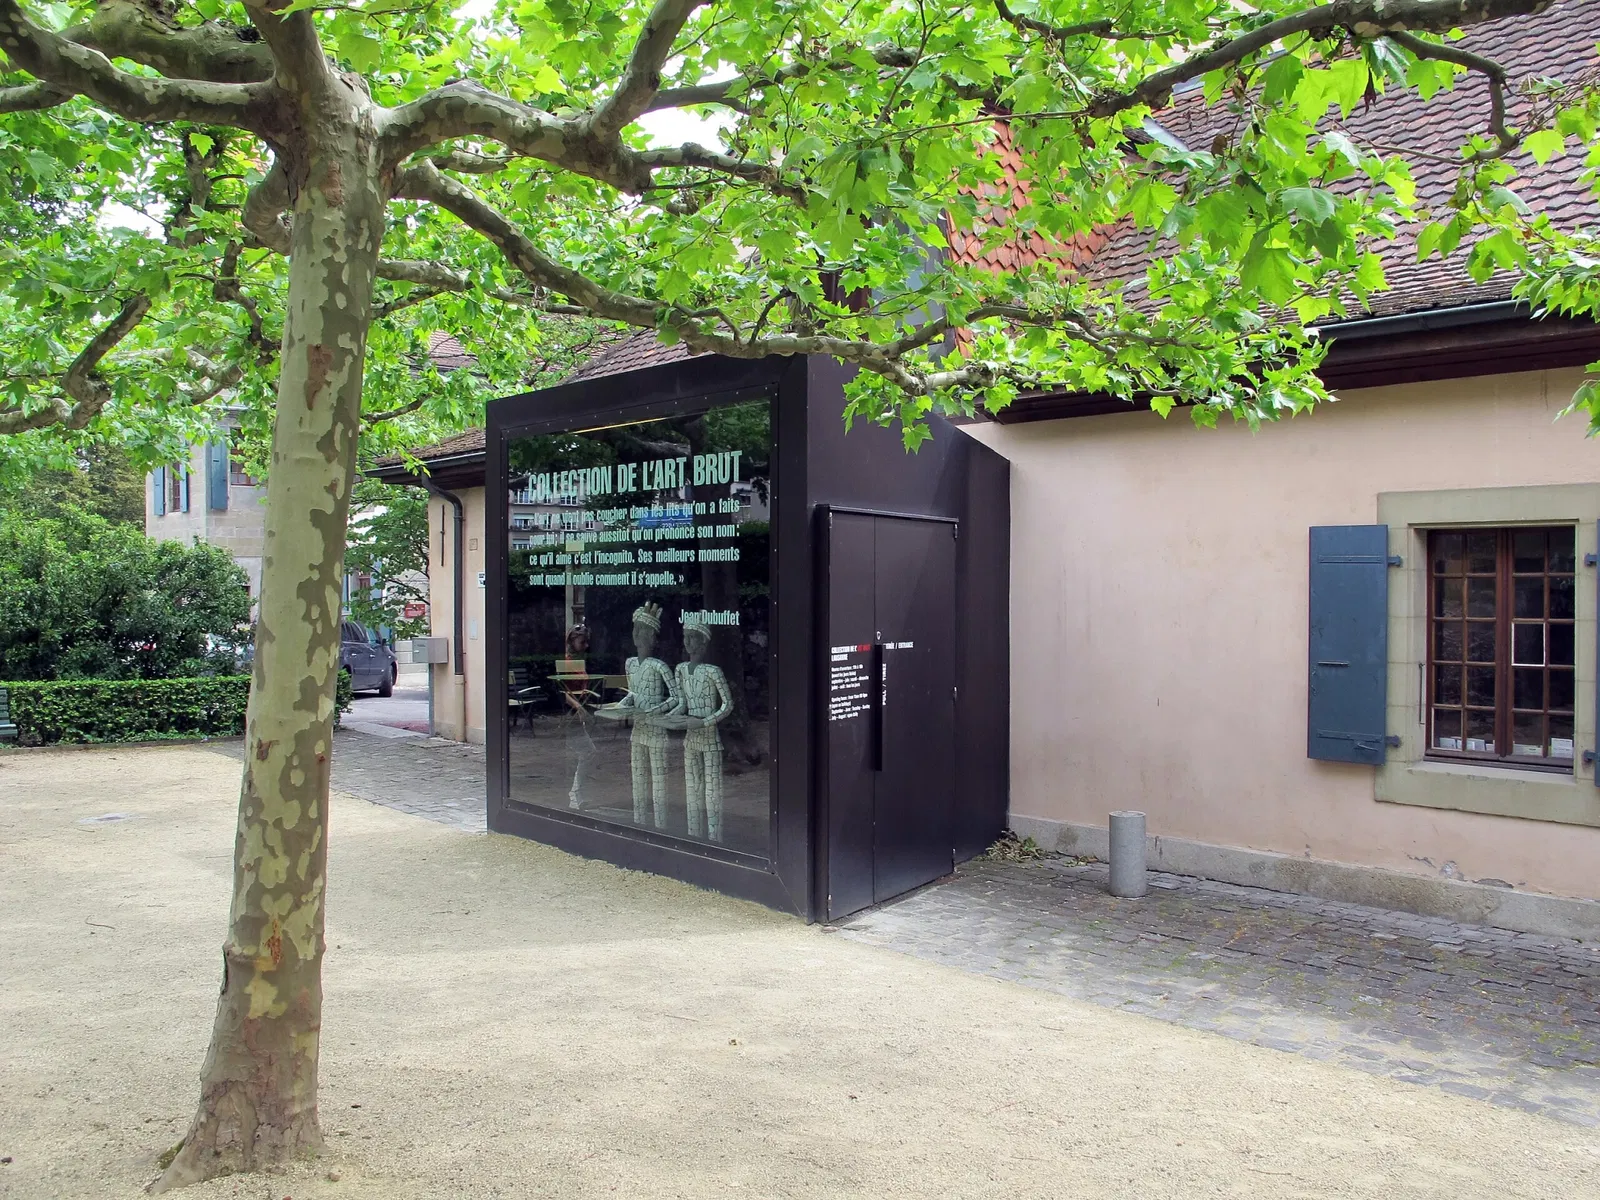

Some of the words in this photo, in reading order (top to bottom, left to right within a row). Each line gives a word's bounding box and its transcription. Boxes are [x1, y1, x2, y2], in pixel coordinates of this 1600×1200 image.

[529, 466, 612, 501] COLLECTION
[617, 463, 637, 493] DE
[642, 456, 687, 491] L'ART
[693, 450, 742, 486] BRUT
[597, 507, 628, 520] coucher
[630, 504, 648, 518] dans
[651, 503, 663, 517] les
[666, 502, 680, 516] lits
[682, 500, 706, 518] qu'on
[709, 502, 716, 514] a
[719, 498, 740, 514] faits
[566, 532, 574, 542] se
[576, 532, 597, 542] sauve
[632, 526, 653, 542] qu'on
[655, 525, 695, 542] prononce
[697, 526, 713, 538] son
[530, 554, 538, 565] ce
[539, 552, 553, 567] qu'il
[555, 552, 572, 565] aime
[574, 551, 592, 565] c'est
[594, 549, 635, 565] l'incognito.
[638, 548, 653, 563] Ses
[656, 547, 695, 563] meilleurs
[698, 546, 740, 562] moments
[530, 573, 544, 585] sont
[545, 573, 565, 587] quand
[572, 571, 594, 585] oublie
[595, 572, 630, 585] comment
[631, 571, 637, 585] il
[638, 570, 677, 587] s'appelle.
[678, 608, 701, 625] Jean
[702, 609, 740, 626] Dubuffet
